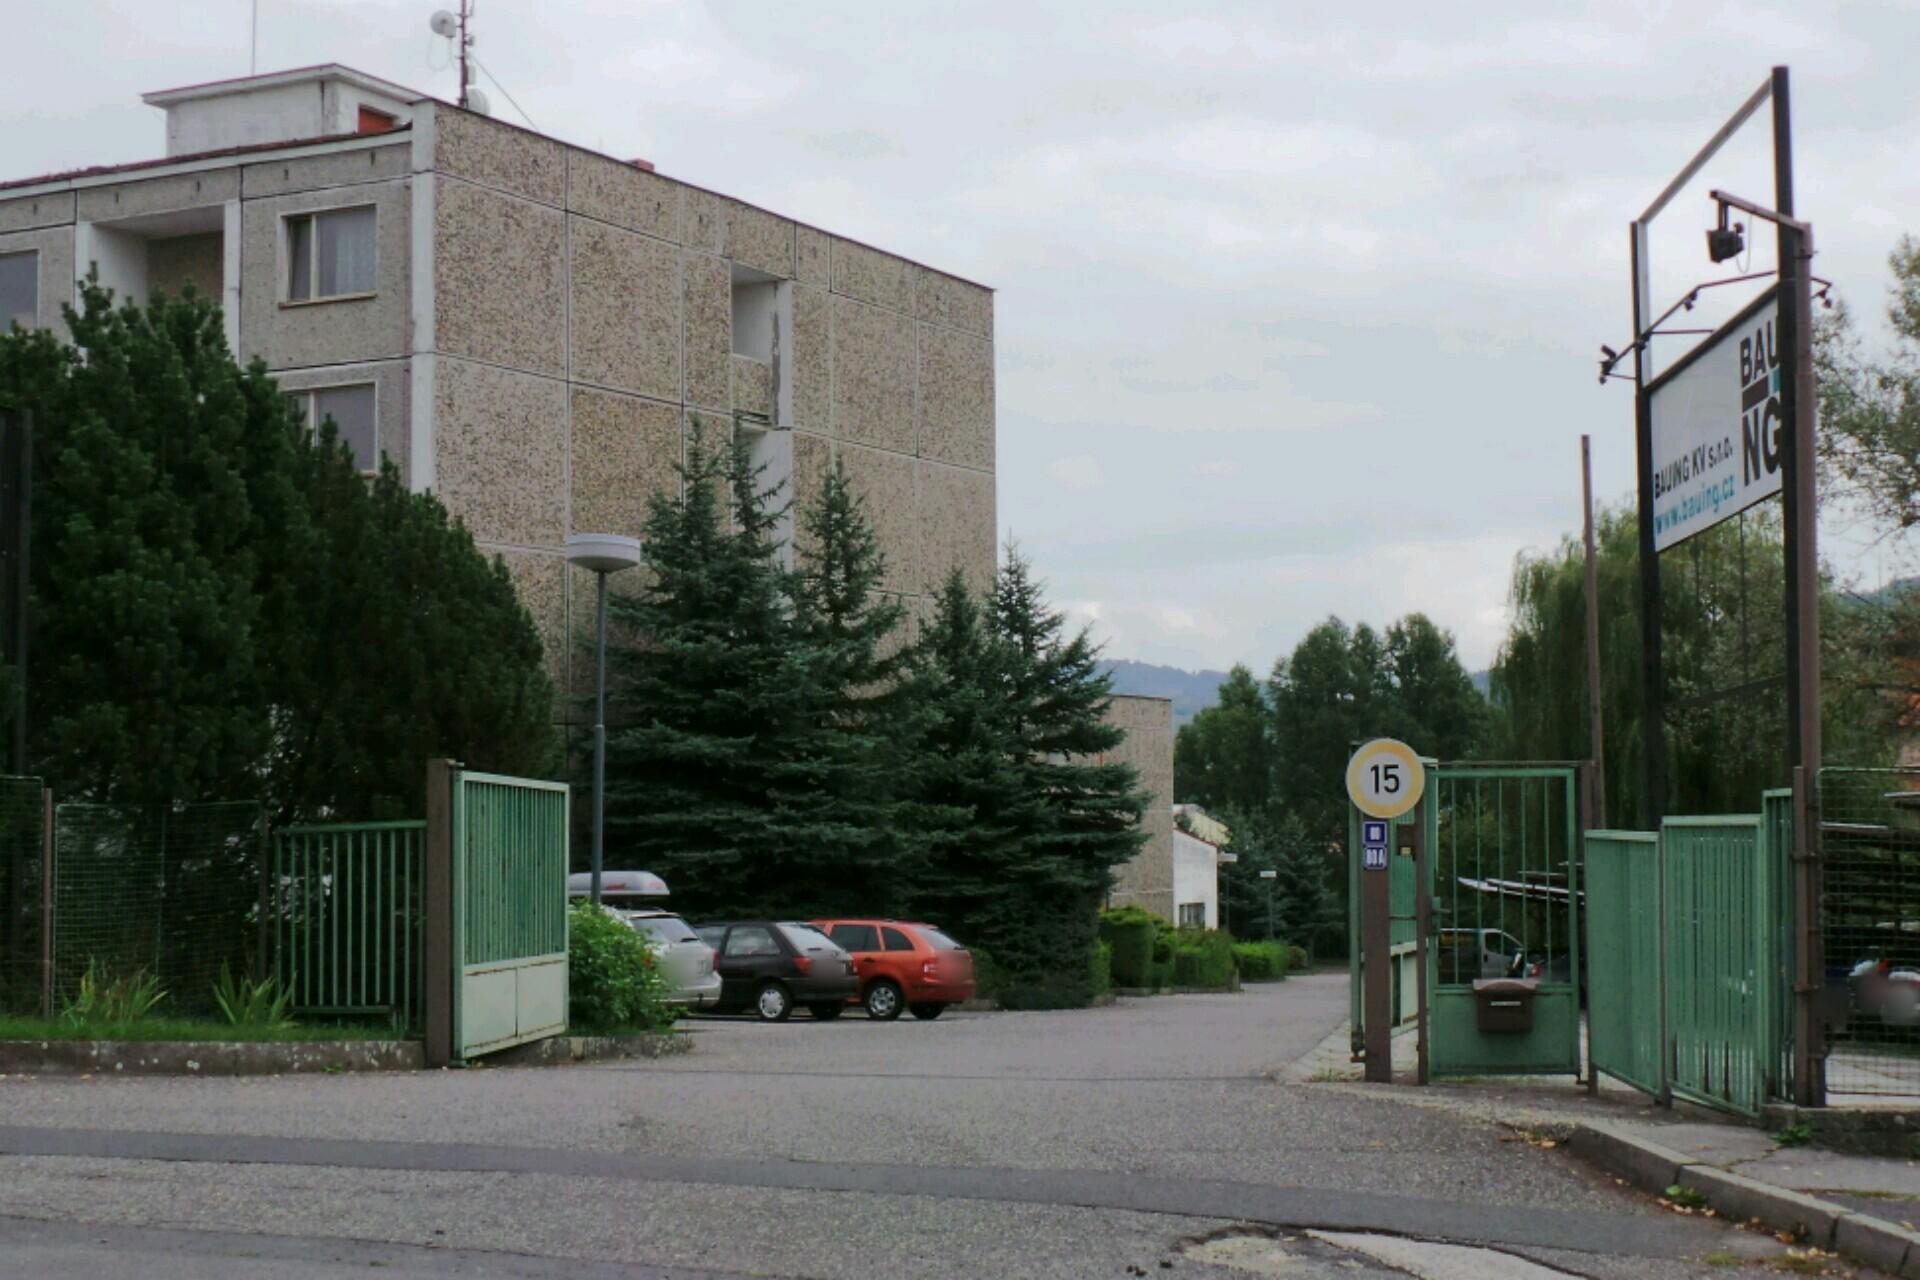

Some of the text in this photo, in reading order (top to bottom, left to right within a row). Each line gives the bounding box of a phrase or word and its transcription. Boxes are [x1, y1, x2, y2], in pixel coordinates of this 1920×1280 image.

[1740, 320, 1780, 388] BAU
[1654, 437, 1733, 499] BAUING KV s.r.o.
[1655, 474, 1736, 535] www.bauing.cz
[1370, 764, 1400, 794] 15
